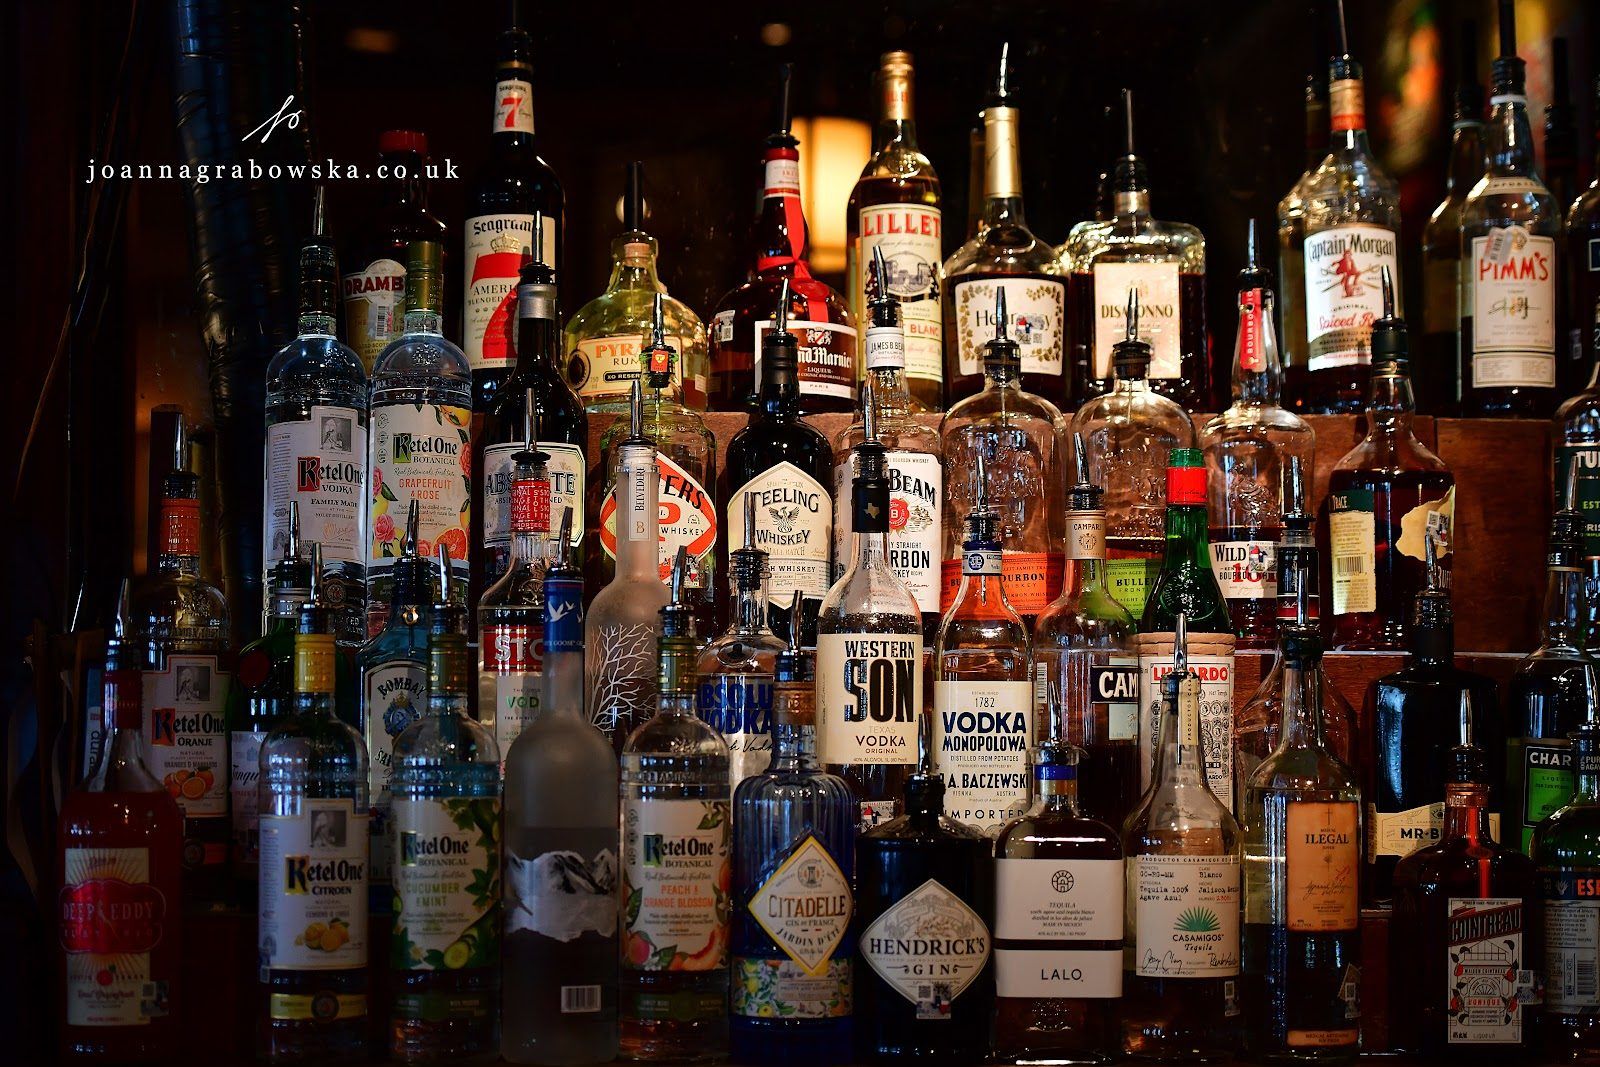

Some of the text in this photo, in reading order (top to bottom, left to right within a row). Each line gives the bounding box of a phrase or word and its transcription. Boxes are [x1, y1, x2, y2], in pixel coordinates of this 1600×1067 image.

[500, 97, 523, 128] 7
[863, 212, 940, 238] LILLET
[1308, 233, 1396, 262] Captain Morgan
[1479, 251, 1549, 281] PIMM'S
[394, 434, 458, 462] Ketel One
[413, 456, 456, 465] BOTANICAL
[299, 458, 364, 490] Ketel One
[321, 484, 353, 494] VODKA
[399, 478, 452, 489] GRAPEFRUIT
[888, 468, 937, 508] BEAM
[417, 491, 440, 500] ROSE
[753, 488, 820, 512] TEELING
[311, 498, 340, 507] FAMILY
[660, 526, 705, 536] WHISKEY
[756, 530, 811, 545] WHISKEY
[896, 541, 922, 549] STRAIGHT
[1214, 544, 1247, 562] WILD
[844, 640, 915, 659] WESTERN
[377, 677, 427, 699] BOMBAY
[843, 658, 915, 723] SON
[975, 696, 995, 708] 1782
[155, 709, 225, 743] Ketel One
[942, 711, 1027, 734] VODKA
[868, 725, 896, 734] TEXAS
[177, 737, 213, 747] ORANJE
[855, 735, 906, 747] VODKA
[942, 735, 1027, 752] MONOPOLOWA
[943, 809, 1024, 820] IMPORTED
[1305, 833, 1350, 844] ILEGAL
[440, 836, 469, 855] One
[645, 834, 714, 865] Ketel One
[418, 858, 470, 866] BOTANICAL
[665, 859, 714, 868] BOTANICAL
[288, 859, 363, 892] Ketel One
[312, 885, 352, 896] CITROEN
[405, 882, 460, 894] CUCUMBER
[661, 885, 691, 895] PEACH
[1139, 884, 1189, 894] Tequila 100%
[422, 895, 448, 907] MINT
[644, 897, 714, 908] ORANGE BLOSSOM
[768, 894, 846, 918] CITADELLE
[63, 901, 153, 920] DEEP EDDY
[1451, 907, 1521, 942] COINTREAU
[776, 927, 814, 946] JARDIN
[1172, 934, 1222, 942] CASAMIGOS
[869, 936, 985, 956] HENDRICK'S
[1184, 943, 1213, 953] Tequila
[913, 964, 950, 975] GIN
